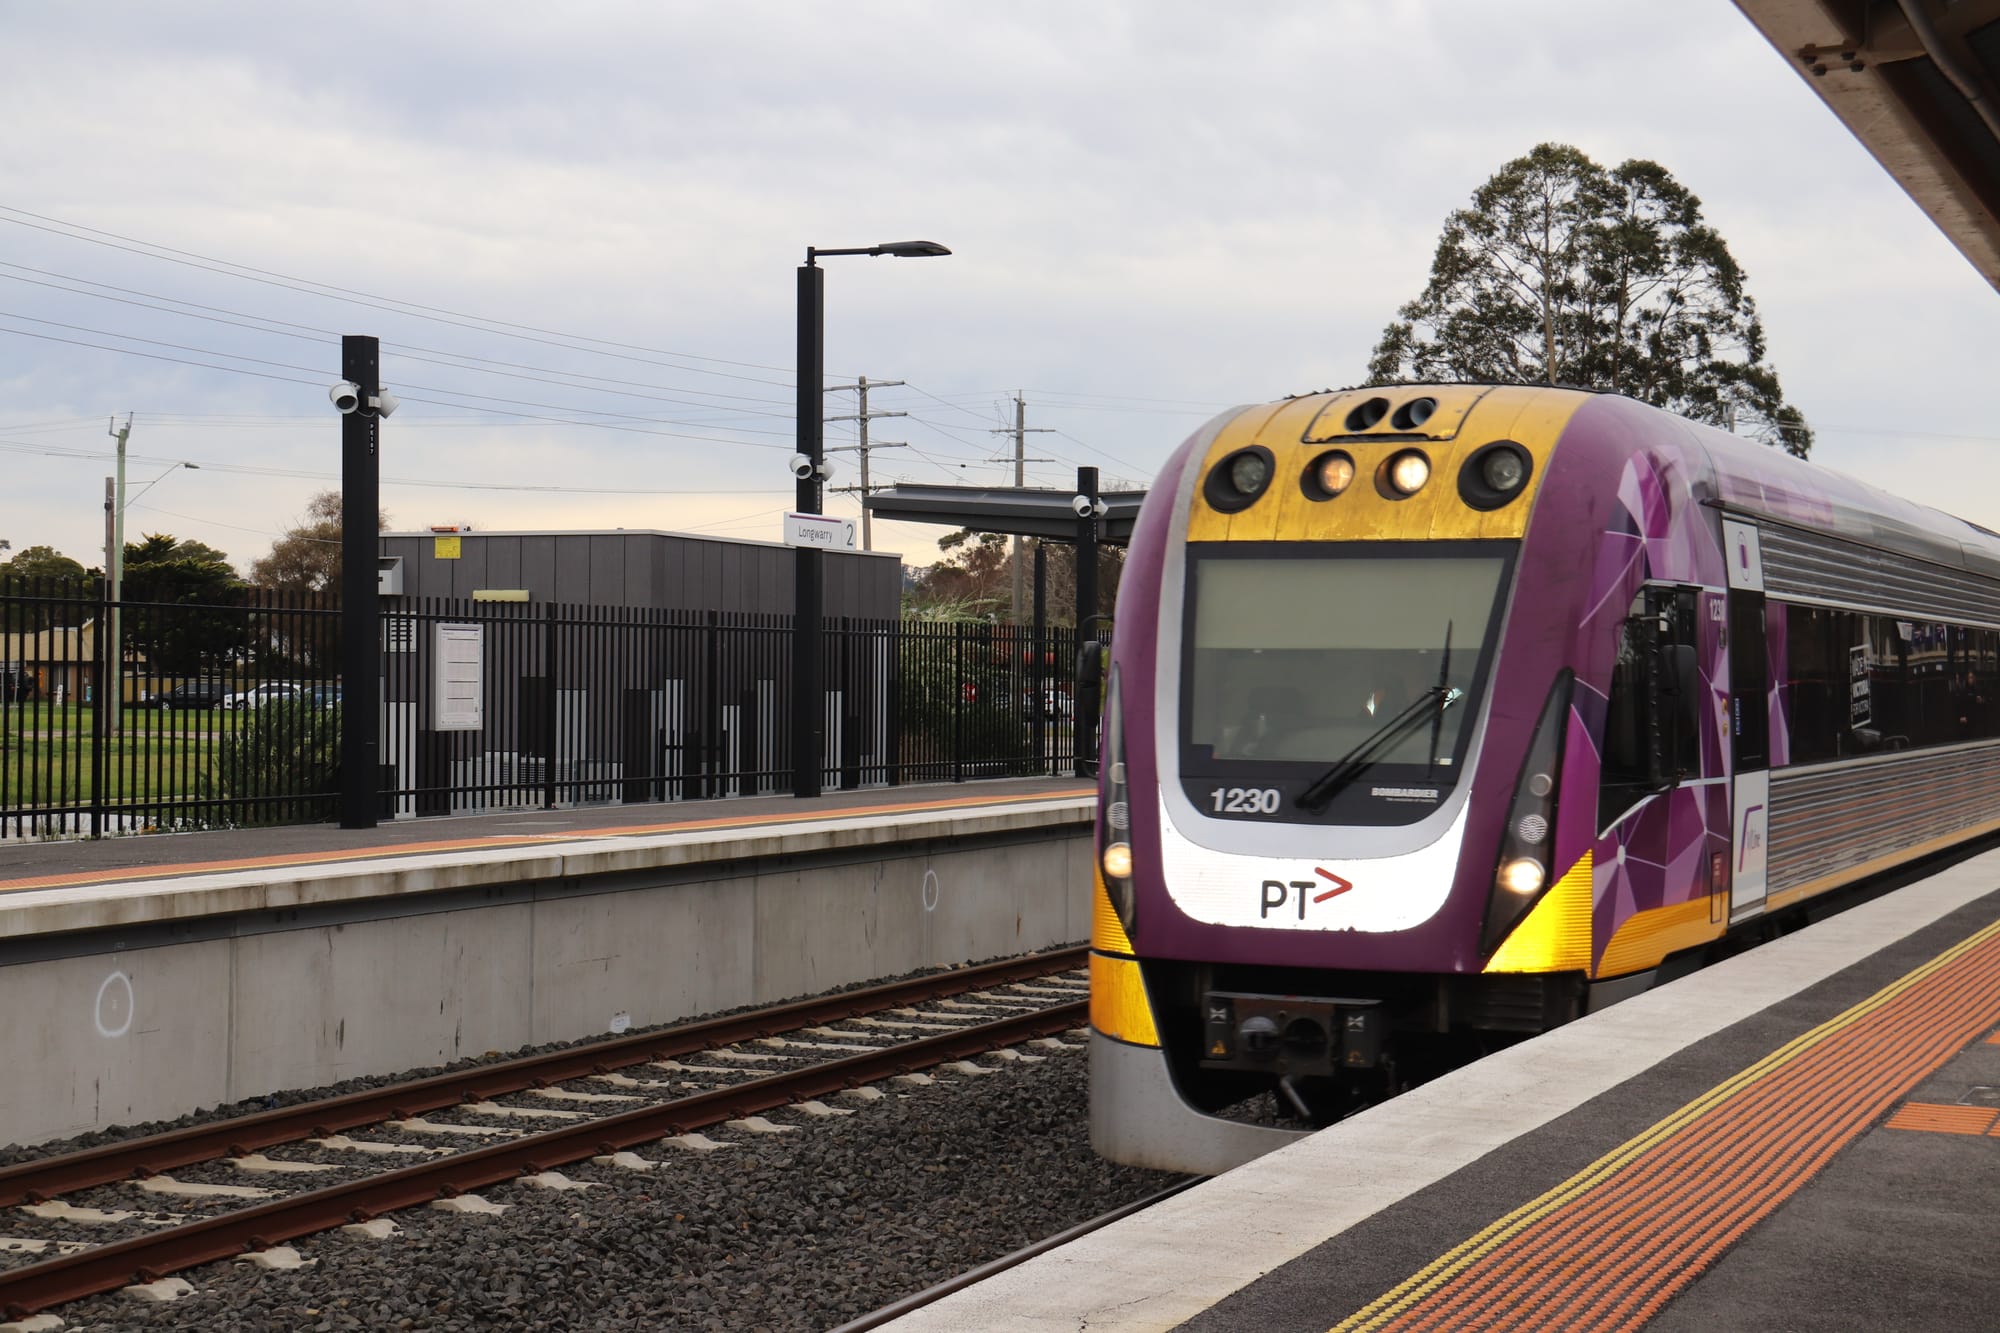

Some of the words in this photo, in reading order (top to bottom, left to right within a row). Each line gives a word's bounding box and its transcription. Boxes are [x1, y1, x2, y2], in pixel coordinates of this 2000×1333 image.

[798, 525, 833, 543] Longwarry
[846, 523, 854, 546] 2
[1210, 787, 1281, 814] 1230
[1371, 787, 1439, 798] BOMBARDIER
